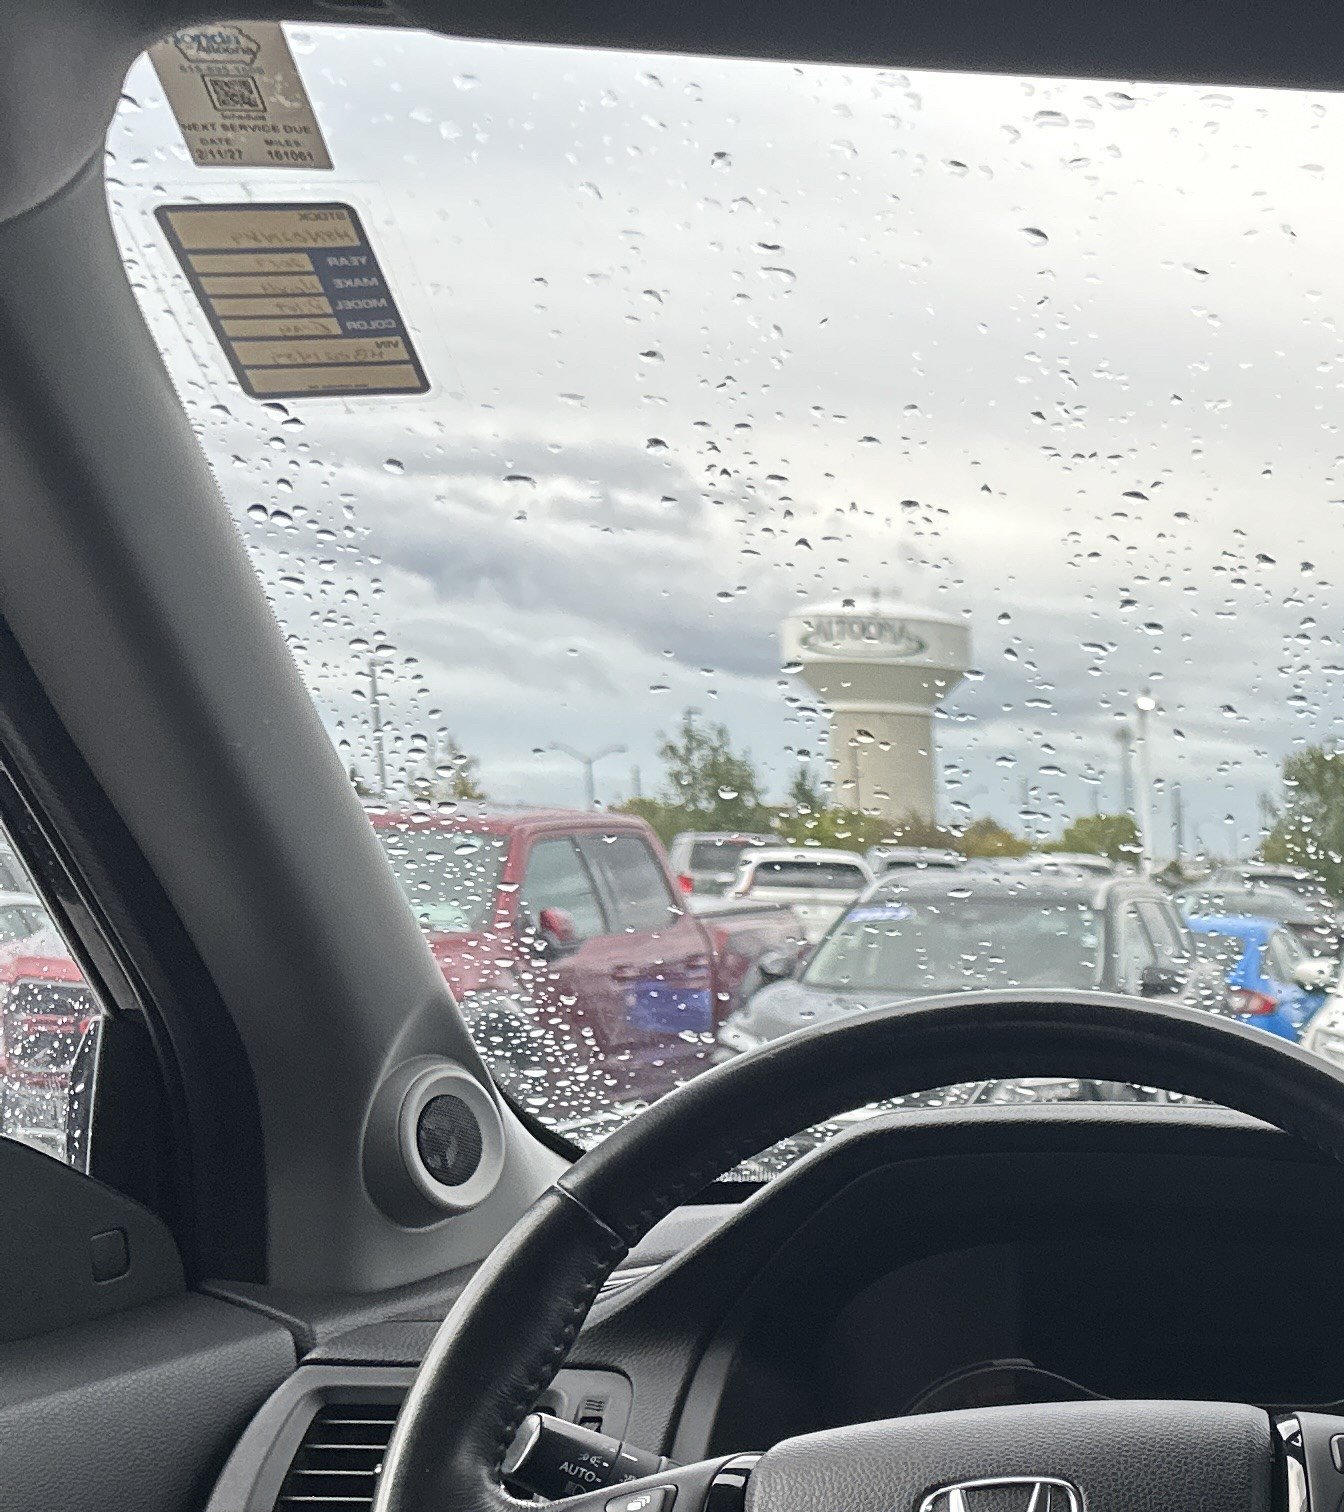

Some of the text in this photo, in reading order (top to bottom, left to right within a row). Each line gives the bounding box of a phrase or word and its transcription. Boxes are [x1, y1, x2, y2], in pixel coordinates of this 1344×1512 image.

[180, 122, 312, 134] NEXT SERVICE DUE
[199, 137, 232, 146] DATE
[559, 1461, 596, 1483] AUTO
